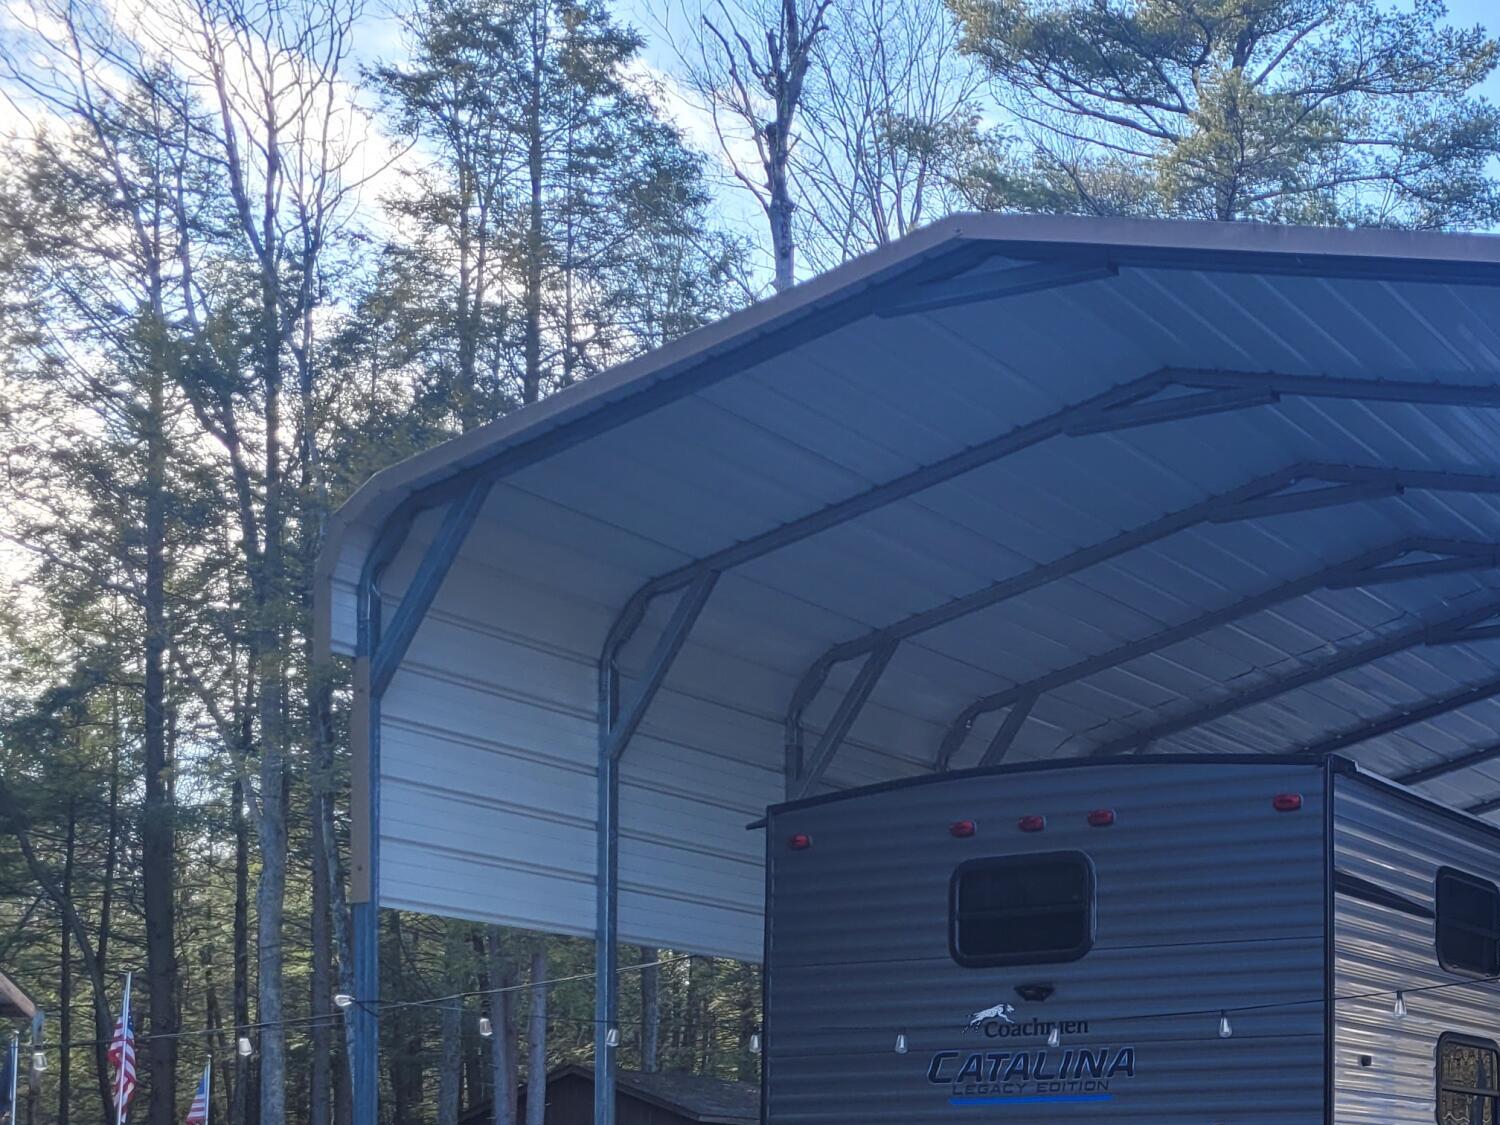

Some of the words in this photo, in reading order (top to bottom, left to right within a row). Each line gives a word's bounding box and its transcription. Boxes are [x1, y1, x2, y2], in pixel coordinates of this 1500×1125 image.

[927, 1047, 1136, 1085] CATALINA
[952, 1082, 1027, 1096] LEGACY
[1036, 1079, 1110, 1094] EDITION
